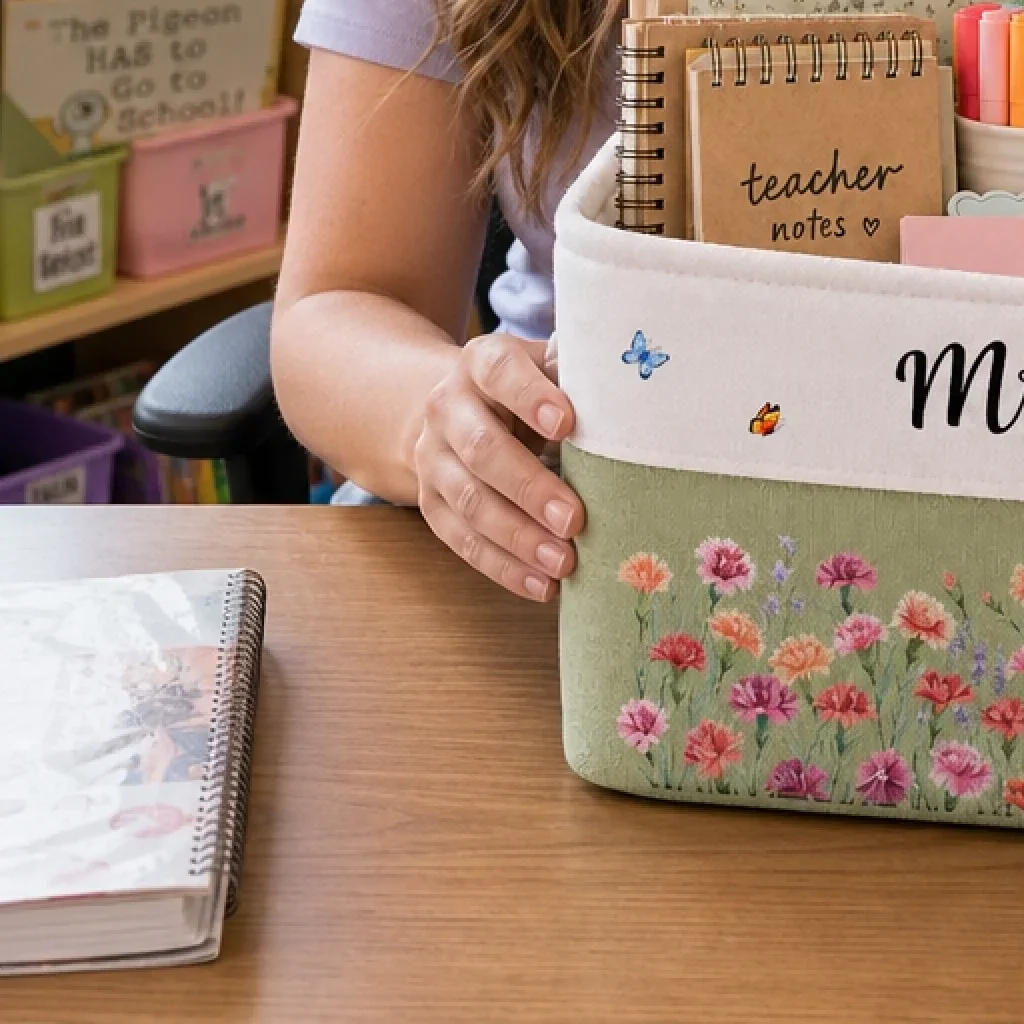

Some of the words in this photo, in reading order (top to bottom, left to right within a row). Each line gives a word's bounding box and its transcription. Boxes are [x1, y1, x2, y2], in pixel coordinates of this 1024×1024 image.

[128, 3, 242, 36] Pigeon
[169, 38, 206, 62] to
[110, 74, 154, 102] Go
[169, 69, 206, 94] to
[741, 149, 904, 206] teacher
[771, 212, 846, 242] notes
